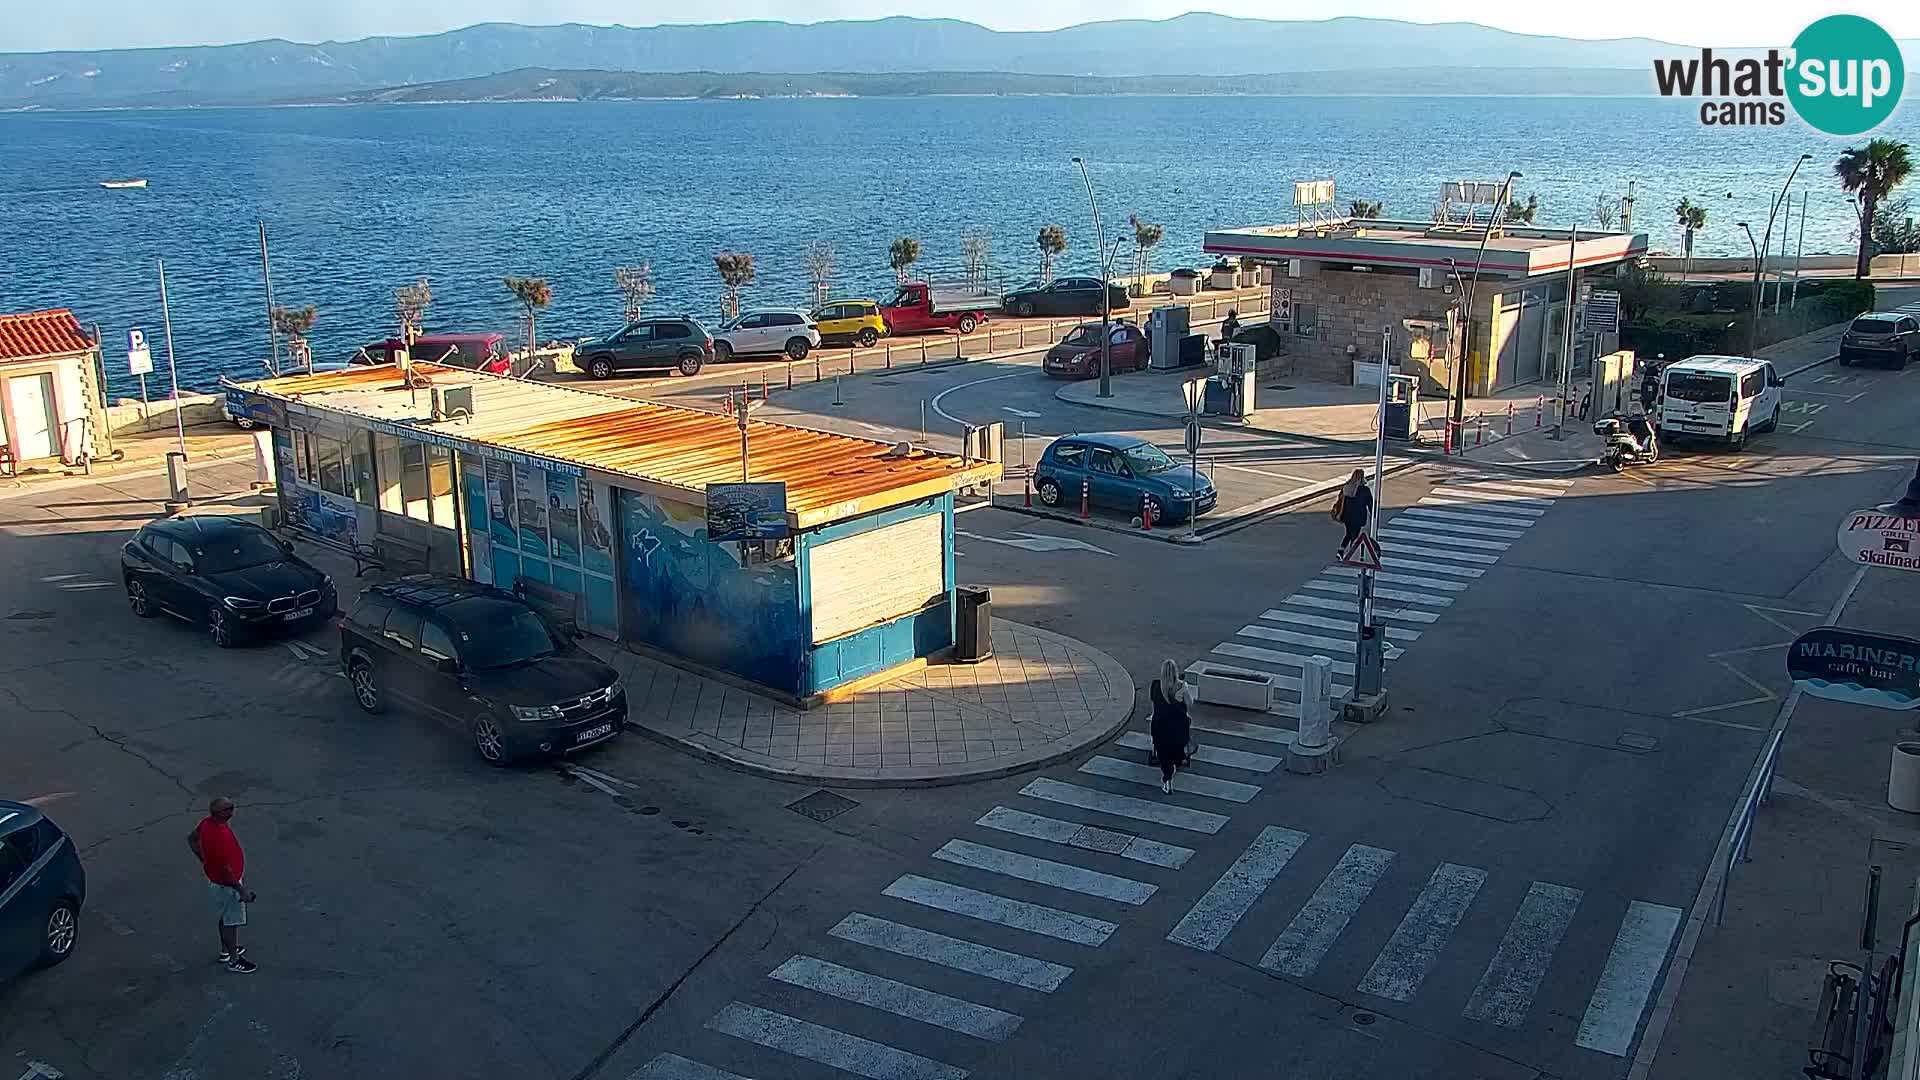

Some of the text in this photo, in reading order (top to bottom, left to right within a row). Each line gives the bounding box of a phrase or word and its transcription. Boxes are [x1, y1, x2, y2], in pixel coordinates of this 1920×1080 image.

[480, 446, 493, 457] BUS
[495, 450, 526, 465] STATION
[529, 457, 554, 470] TICKET
[556, 461, 582, 477] OFFICE
[1828, 662, 1896, 680] caffe bar
